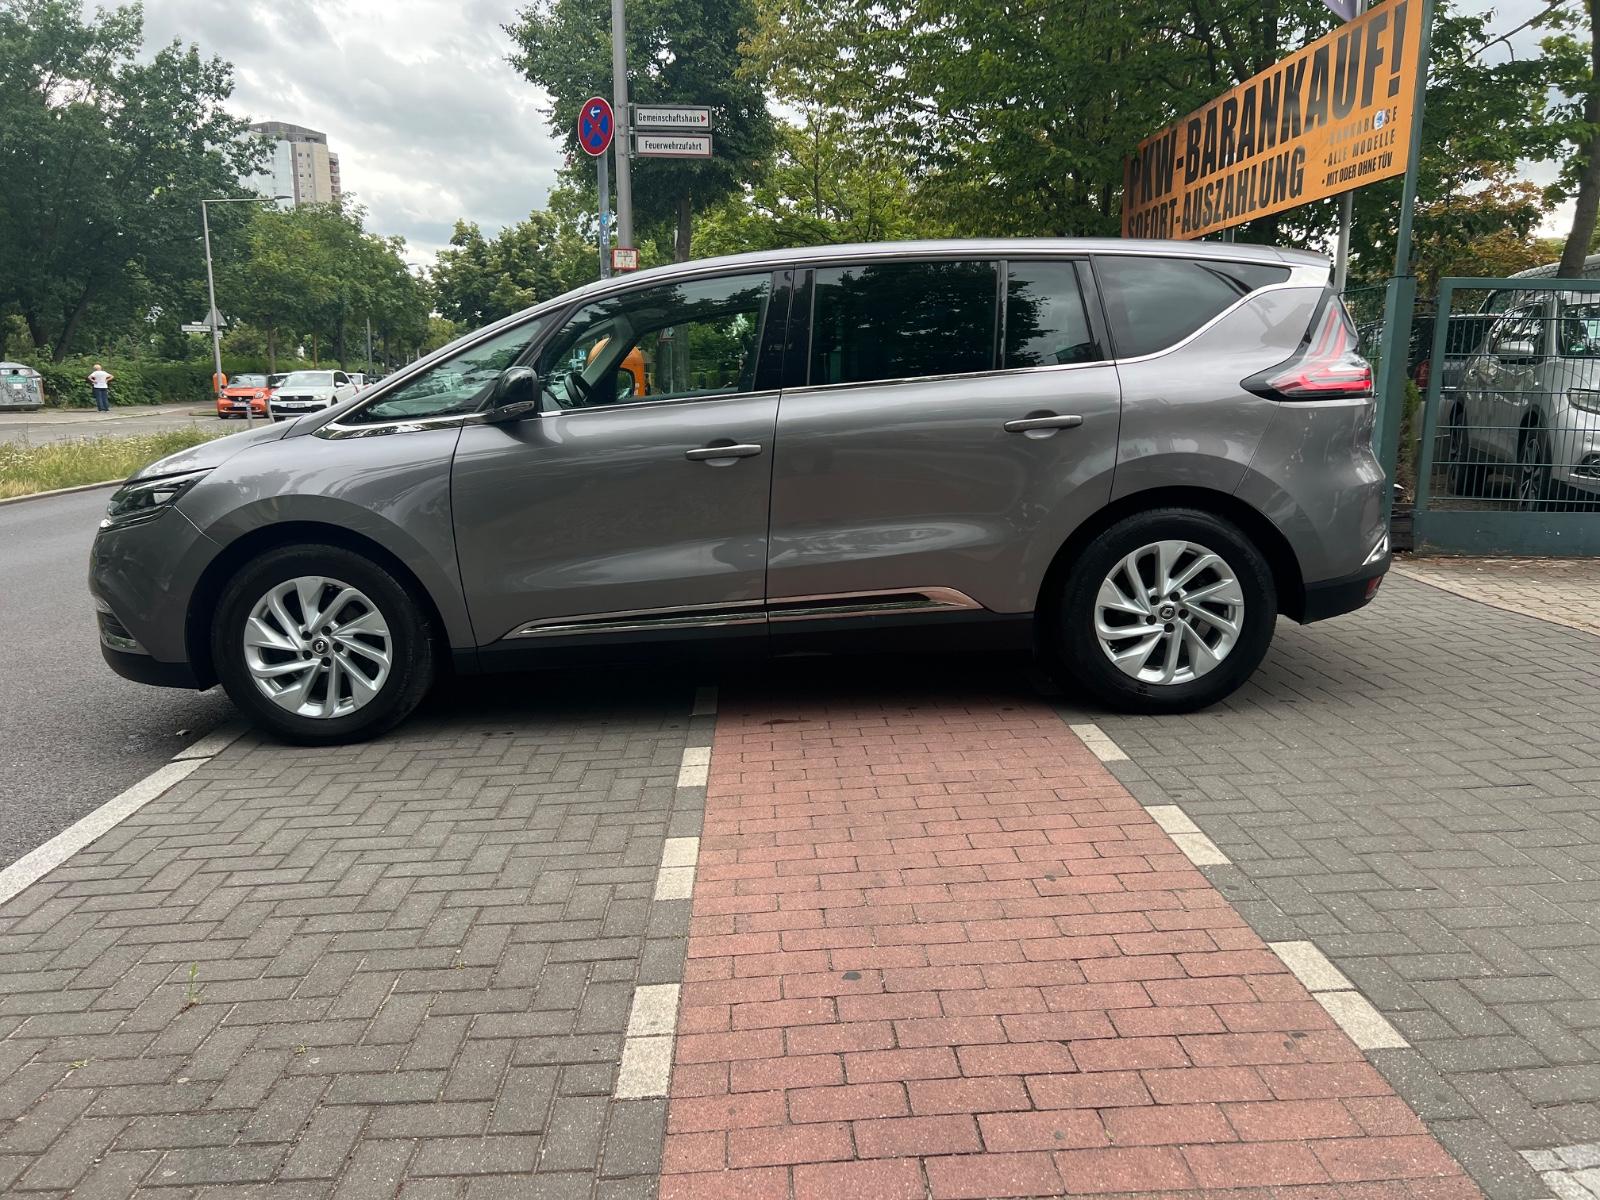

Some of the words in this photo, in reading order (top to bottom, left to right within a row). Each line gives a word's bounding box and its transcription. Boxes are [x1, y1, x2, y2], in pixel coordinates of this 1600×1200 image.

[638, 112, 701, 123] Gemeinschaftshaus
[1129, 1, 1408, 208] PKW-BARANKAUF!
[644, 140, 702, 151] Feuerwehrzufahrt
[1327, 149, 1347, 167] ALLE
[1352, 129, 1395, 157] MODELLE
[1326, 169, 1339, 187] MIT
[1339, 163, 1357, 182] ODER
[1357, 156, 1377, 177] OHNE
[1377, 152, 1393, 169] TÜV
[1128, 146, 1305, 239] SOFORT-AUSZAHLUNG
